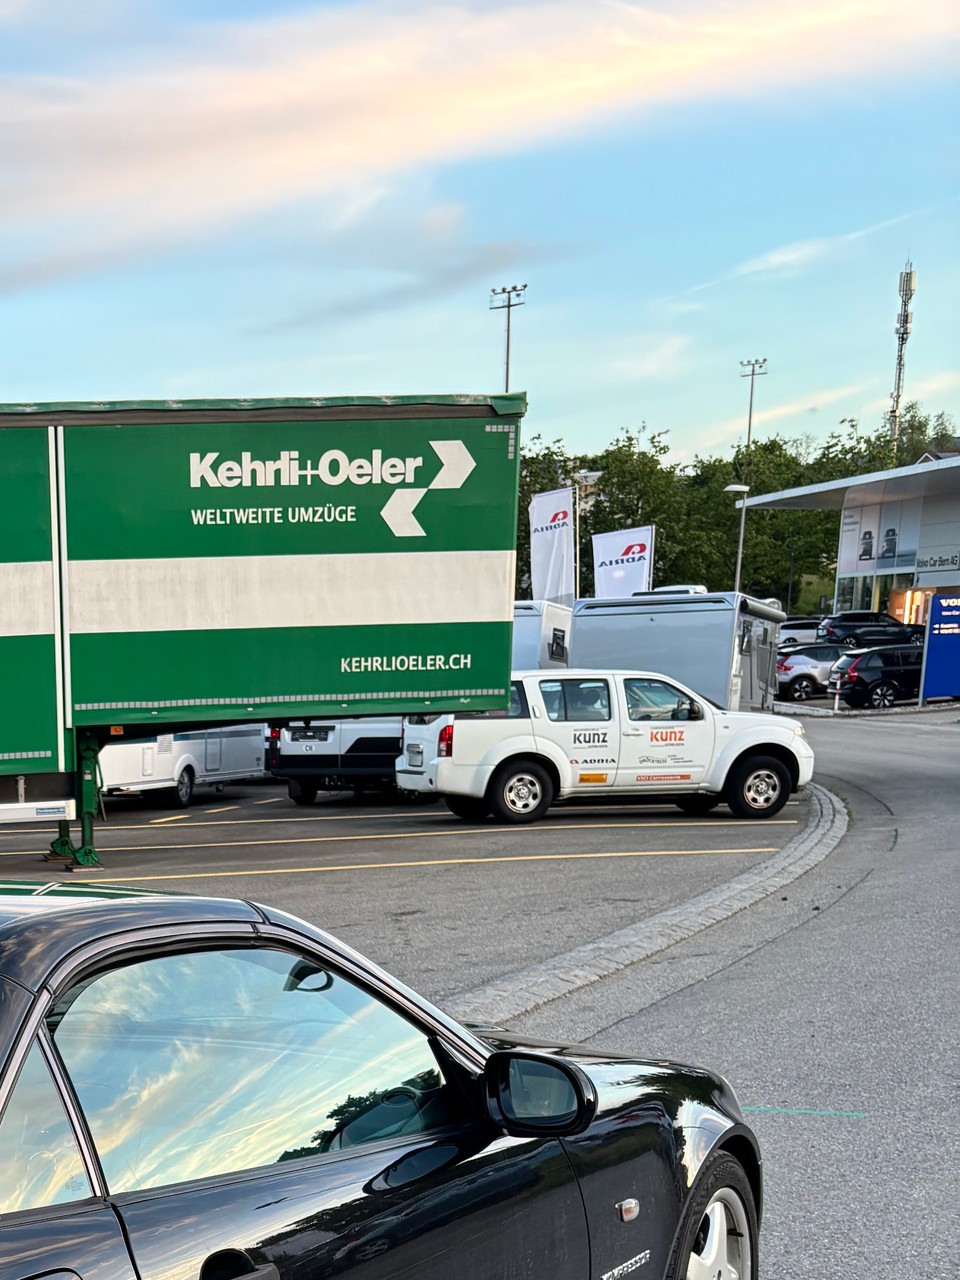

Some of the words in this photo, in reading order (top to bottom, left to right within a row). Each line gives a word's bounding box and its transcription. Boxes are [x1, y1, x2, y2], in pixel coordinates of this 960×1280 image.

[190, 507, 284, 526] WELTWEITE
[288, 504, 357, 524] UMZÜGE
[340, 653, 472, 673] KEHRLIOELER.CH
